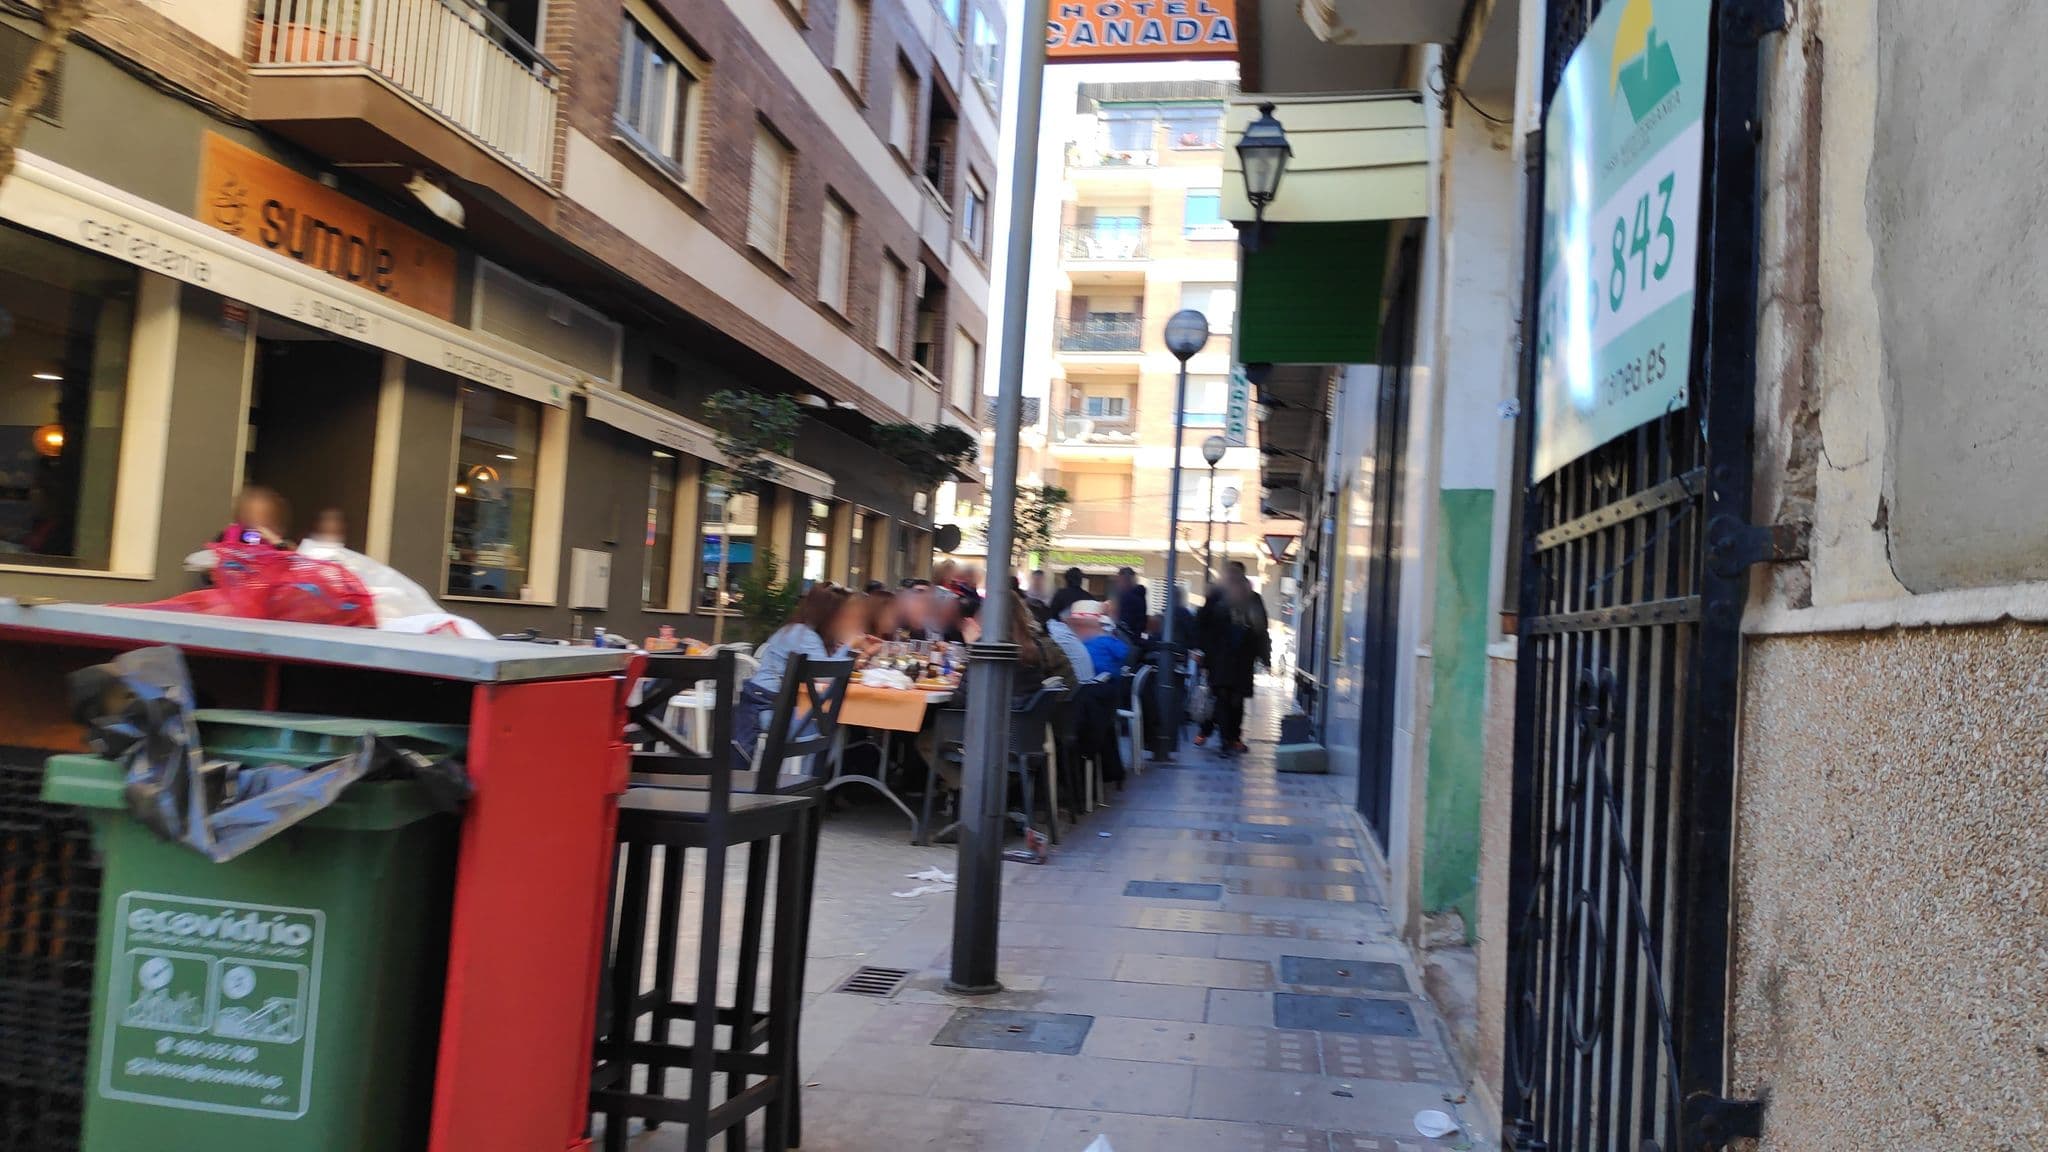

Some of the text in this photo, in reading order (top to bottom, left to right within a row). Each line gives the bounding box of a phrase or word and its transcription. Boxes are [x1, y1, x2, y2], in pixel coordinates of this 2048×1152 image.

[1061, 0, 1220, 18] HOTEL
[1046, 17, 1238, 47] CANADA
[1609, 171, 1675, 313] 843
